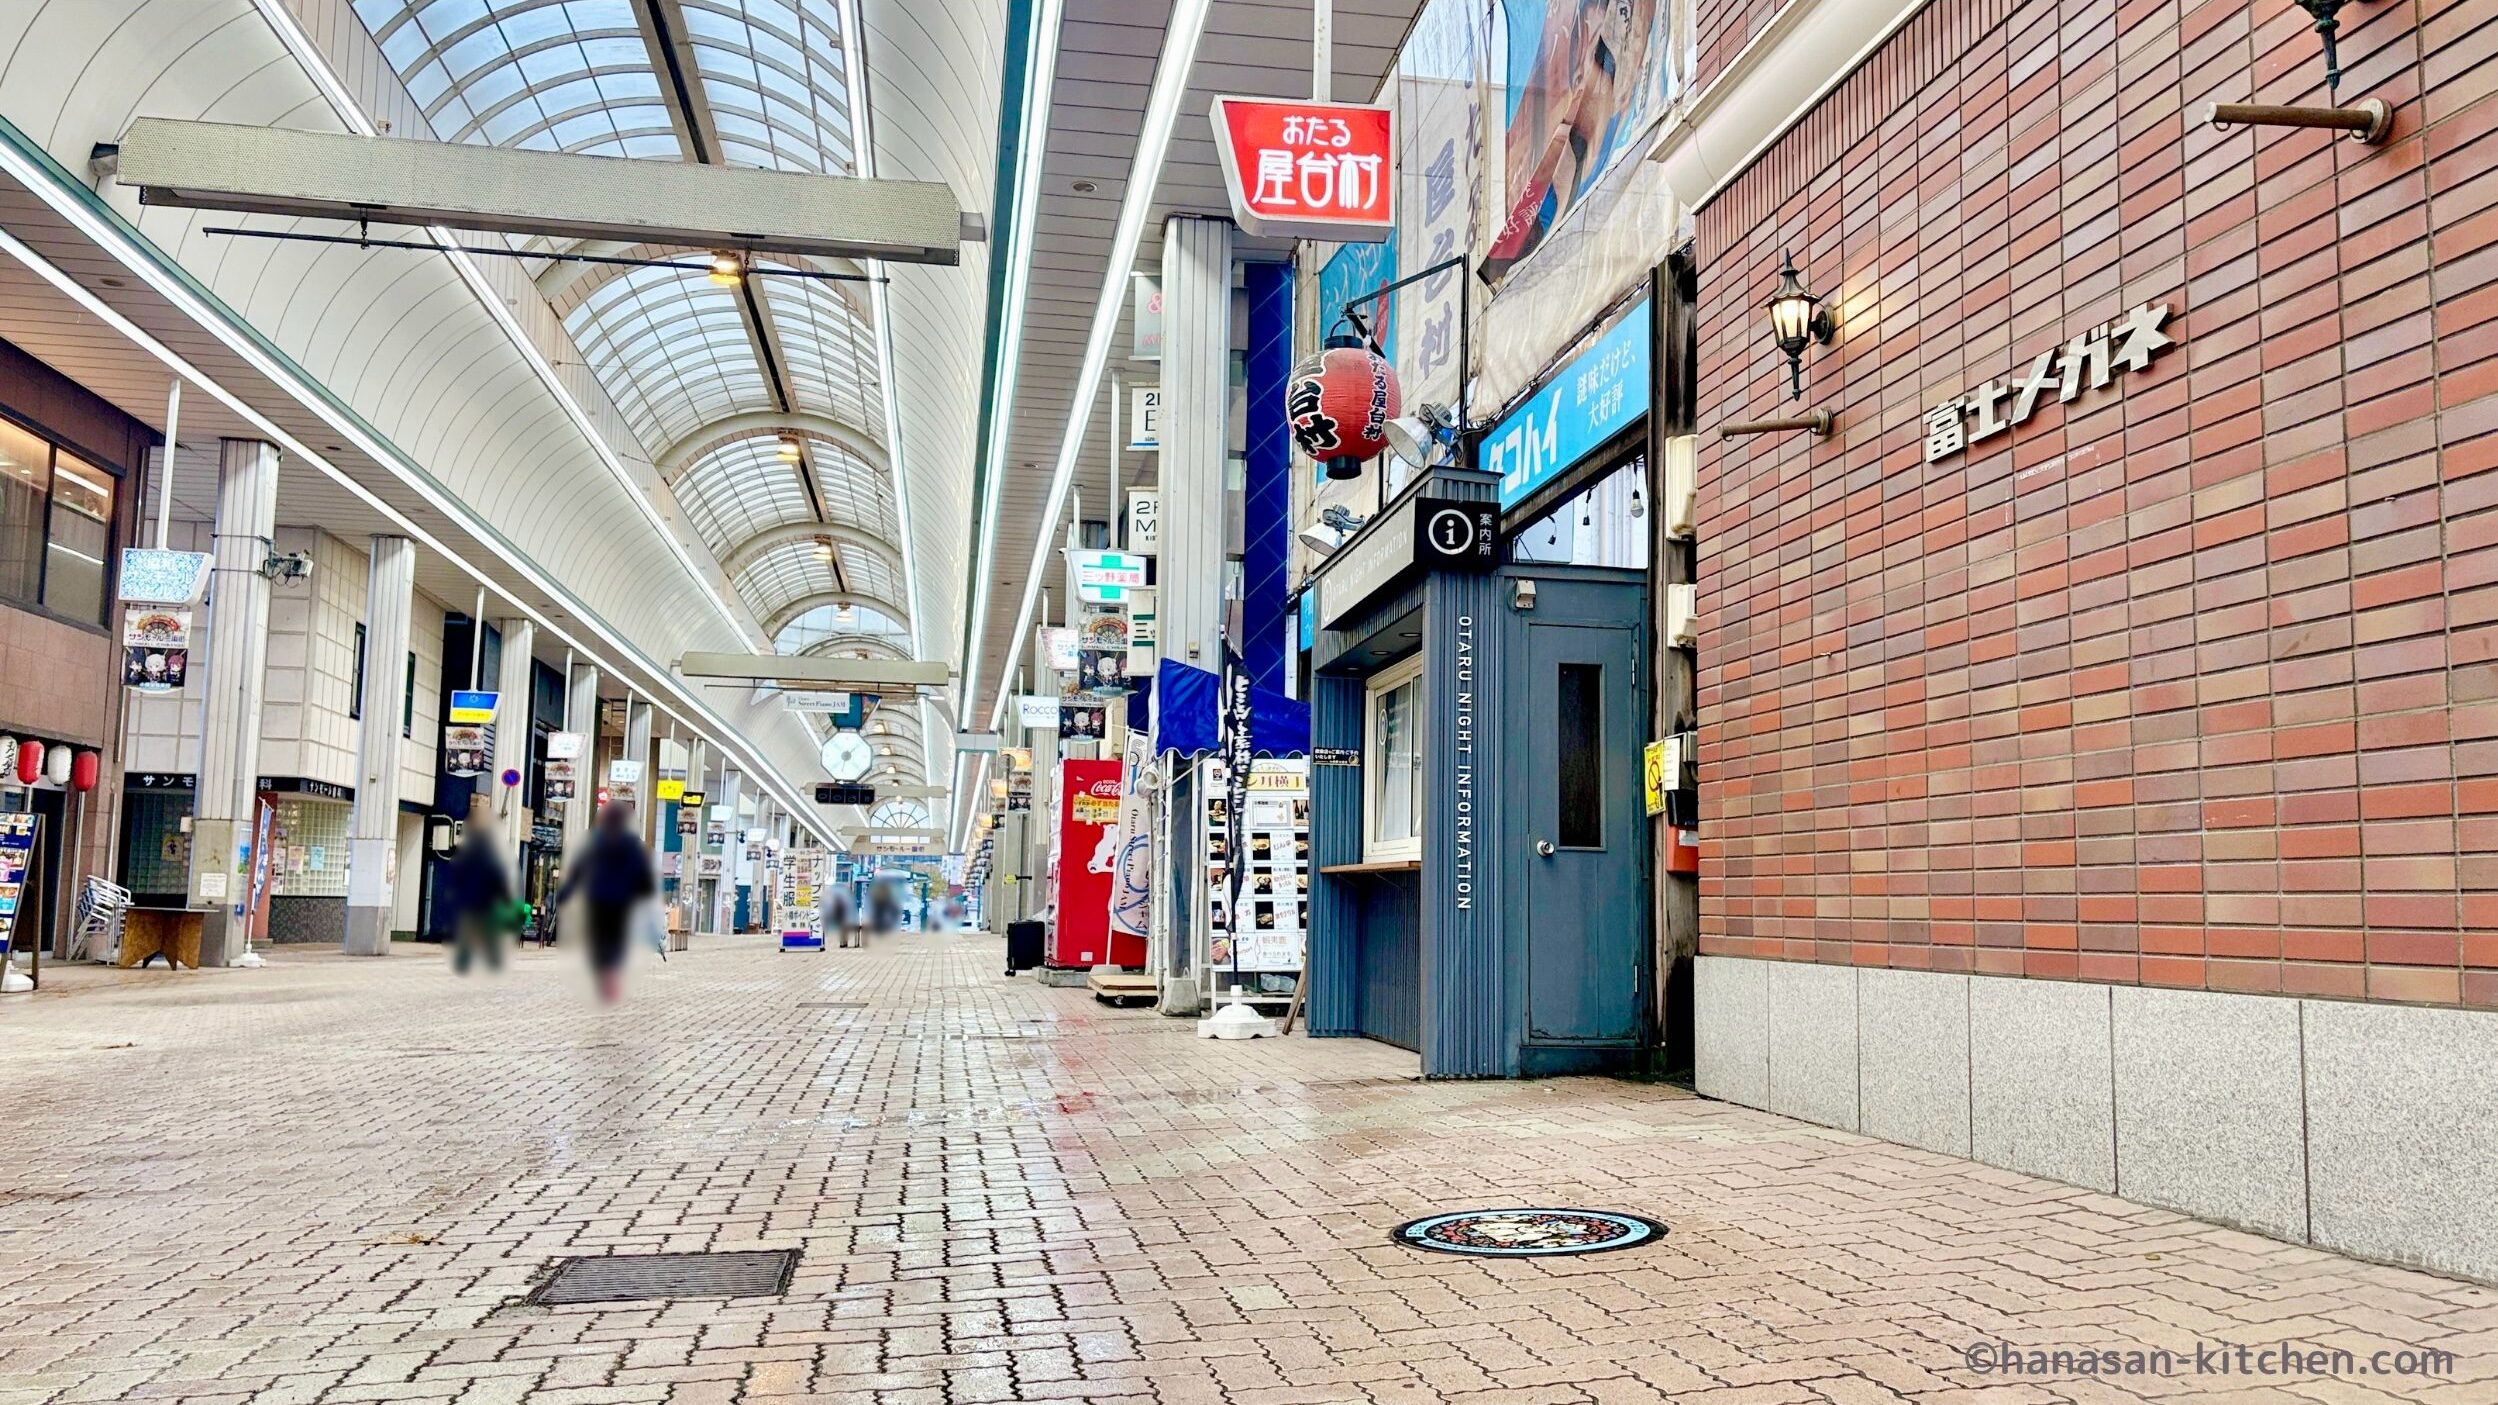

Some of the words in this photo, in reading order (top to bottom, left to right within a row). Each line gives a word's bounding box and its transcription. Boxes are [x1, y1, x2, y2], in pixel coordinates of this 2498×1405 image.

[1283, 115, 1351, 147] おたる
[1251, 149, 1383, 209] 屋台村
[1923, 301, 2178, 463] 富士メガネ
[1479, 513, 1493, 556] 案内所
[1458, 616, 1472, 681] OTARU
[1458, 692, 1472, 754] NIGHT
[143, 775, 194, 787] サンモ
[259, 778, 272, 791] 科
[1457, 765, 1471, 910] INFORMATION
[783, 855, 797, 907] 学生服
